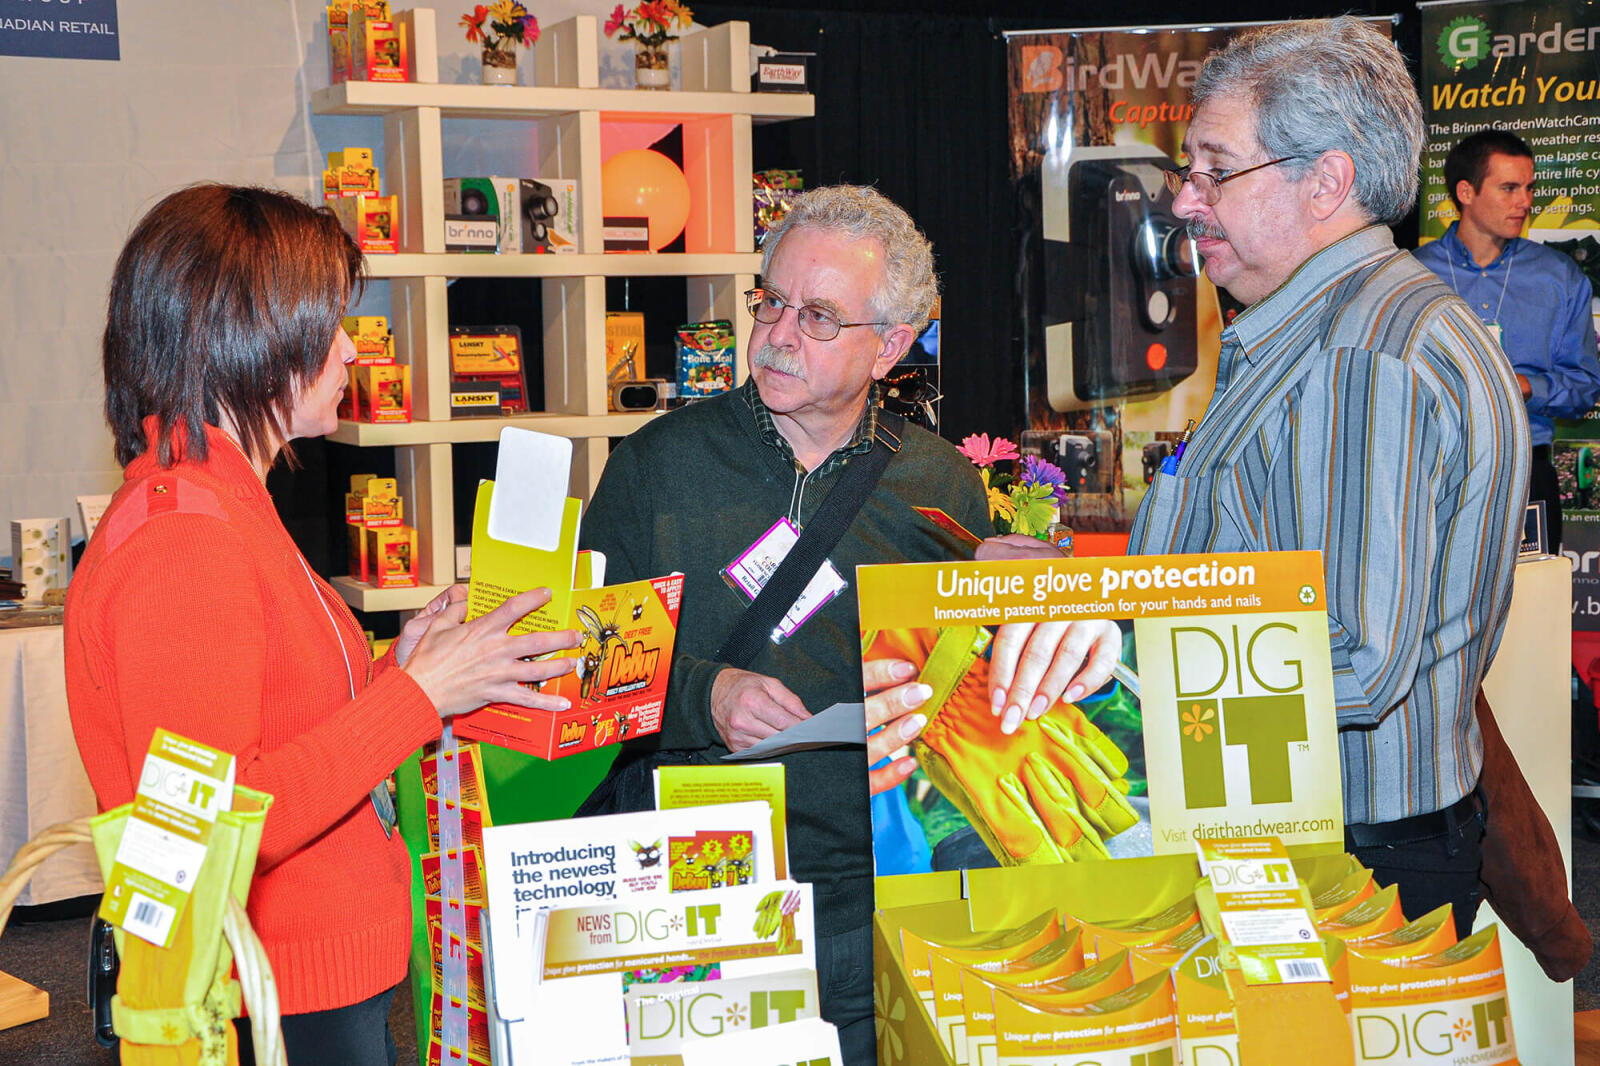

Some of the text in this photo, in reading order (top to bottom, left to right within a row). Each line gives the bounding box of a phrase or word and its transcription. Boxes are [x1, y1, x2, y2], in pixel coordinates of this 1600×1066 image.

[0, 18, 115, 35] ADIAN RETAIL
[1432, 76, 1600, 111] Watch You
[1429, 123, 1449, 135] The
[1429, 141, 1451, 152] cost
[1532, 134, 1581, 147] weather
[1557, 150, 1588, 164] lapse
[1564, 167, 1583, 178] life
[1570, 184, 1600, 198] phot
[688, 354, 711, 363] Bone
[937, 560, 1255, 603] Unique glove protection
[934, 594, 1262, 620] Innovative patent protection for your hands and nails
[1170, 622, 1304, 698] DIG
[1177, 693, 1308, 809] IT
[1161, 818, 1334, 843] Visit digithandwear.com
[511, 844, 616, 867] Introducing
[512, 861, 617, 884] the newest
[1211, 864, 1255, 886] DIG
[1263, 864, 1289, 883] IT
[577, 914, 611, 933] NEWS
[614, 904, 721, 945] DIG IT
[590, 932, 612, 945] from
[577, 960, 614, 973] protection
[624, 955, 665, 967] manicured
[1351, 984, 1378, 994] Unique
[1379, 983, 1399, 994] glove
[1400, 978, 1446, 992] protection
[640, 992, 724, 1040] DIG
[750, 990, 805, 1030] IT
[1187, 1014, 1213, 1024] Unique
[1003, 1031, 1030, 1043] Unique
[1032, 1030, 1051, 1043] glove
[1053, 1027, 1103, 1042] protection
[1116, 1019, 1156, 1034] manicured
[1472, 997, 1507, 1050] IT
[1357, 1010, 1453, 1060] DIG
